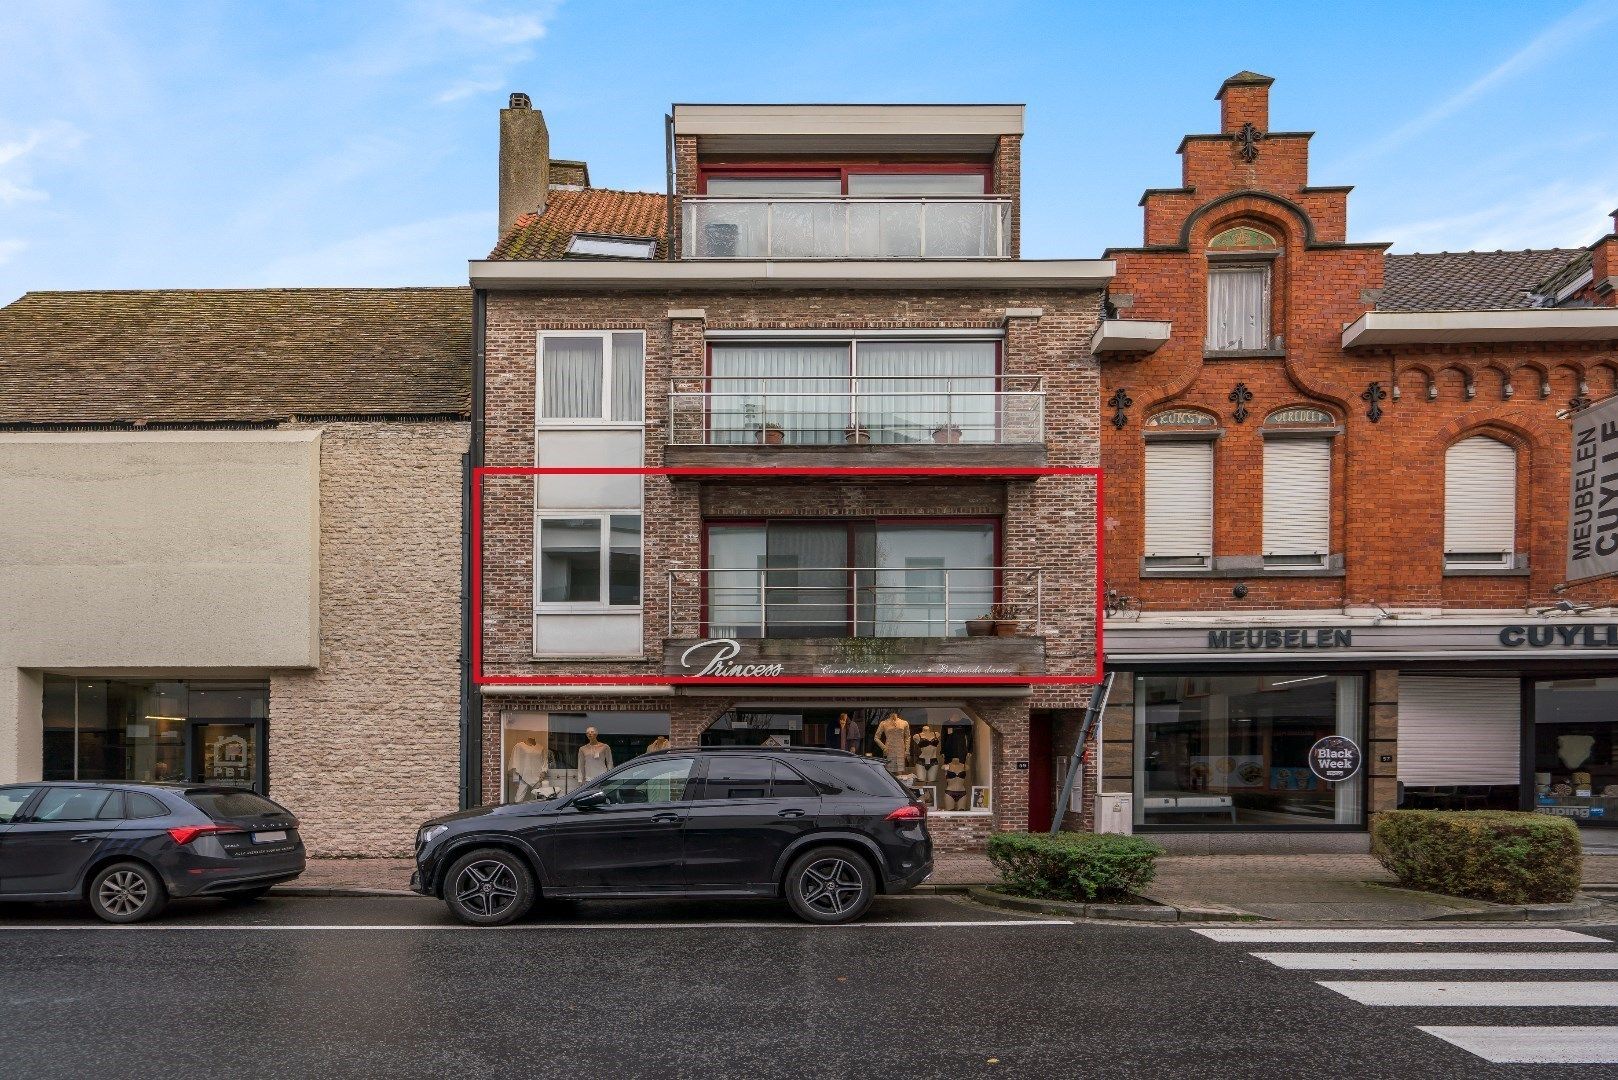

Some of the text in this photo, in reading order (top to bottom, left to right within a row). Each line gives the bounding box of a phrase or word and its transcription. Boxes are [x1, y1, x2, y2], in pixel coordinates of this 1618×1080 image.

[1572, 426, 1597, 561] MEUBELEN
[1208, 629, 1352, 649] MEUBELEN
[681, 638, 784, 678] Princess
[1318, 749, 1353, 758] Black
[1318, 759, 1352, 769] Week
